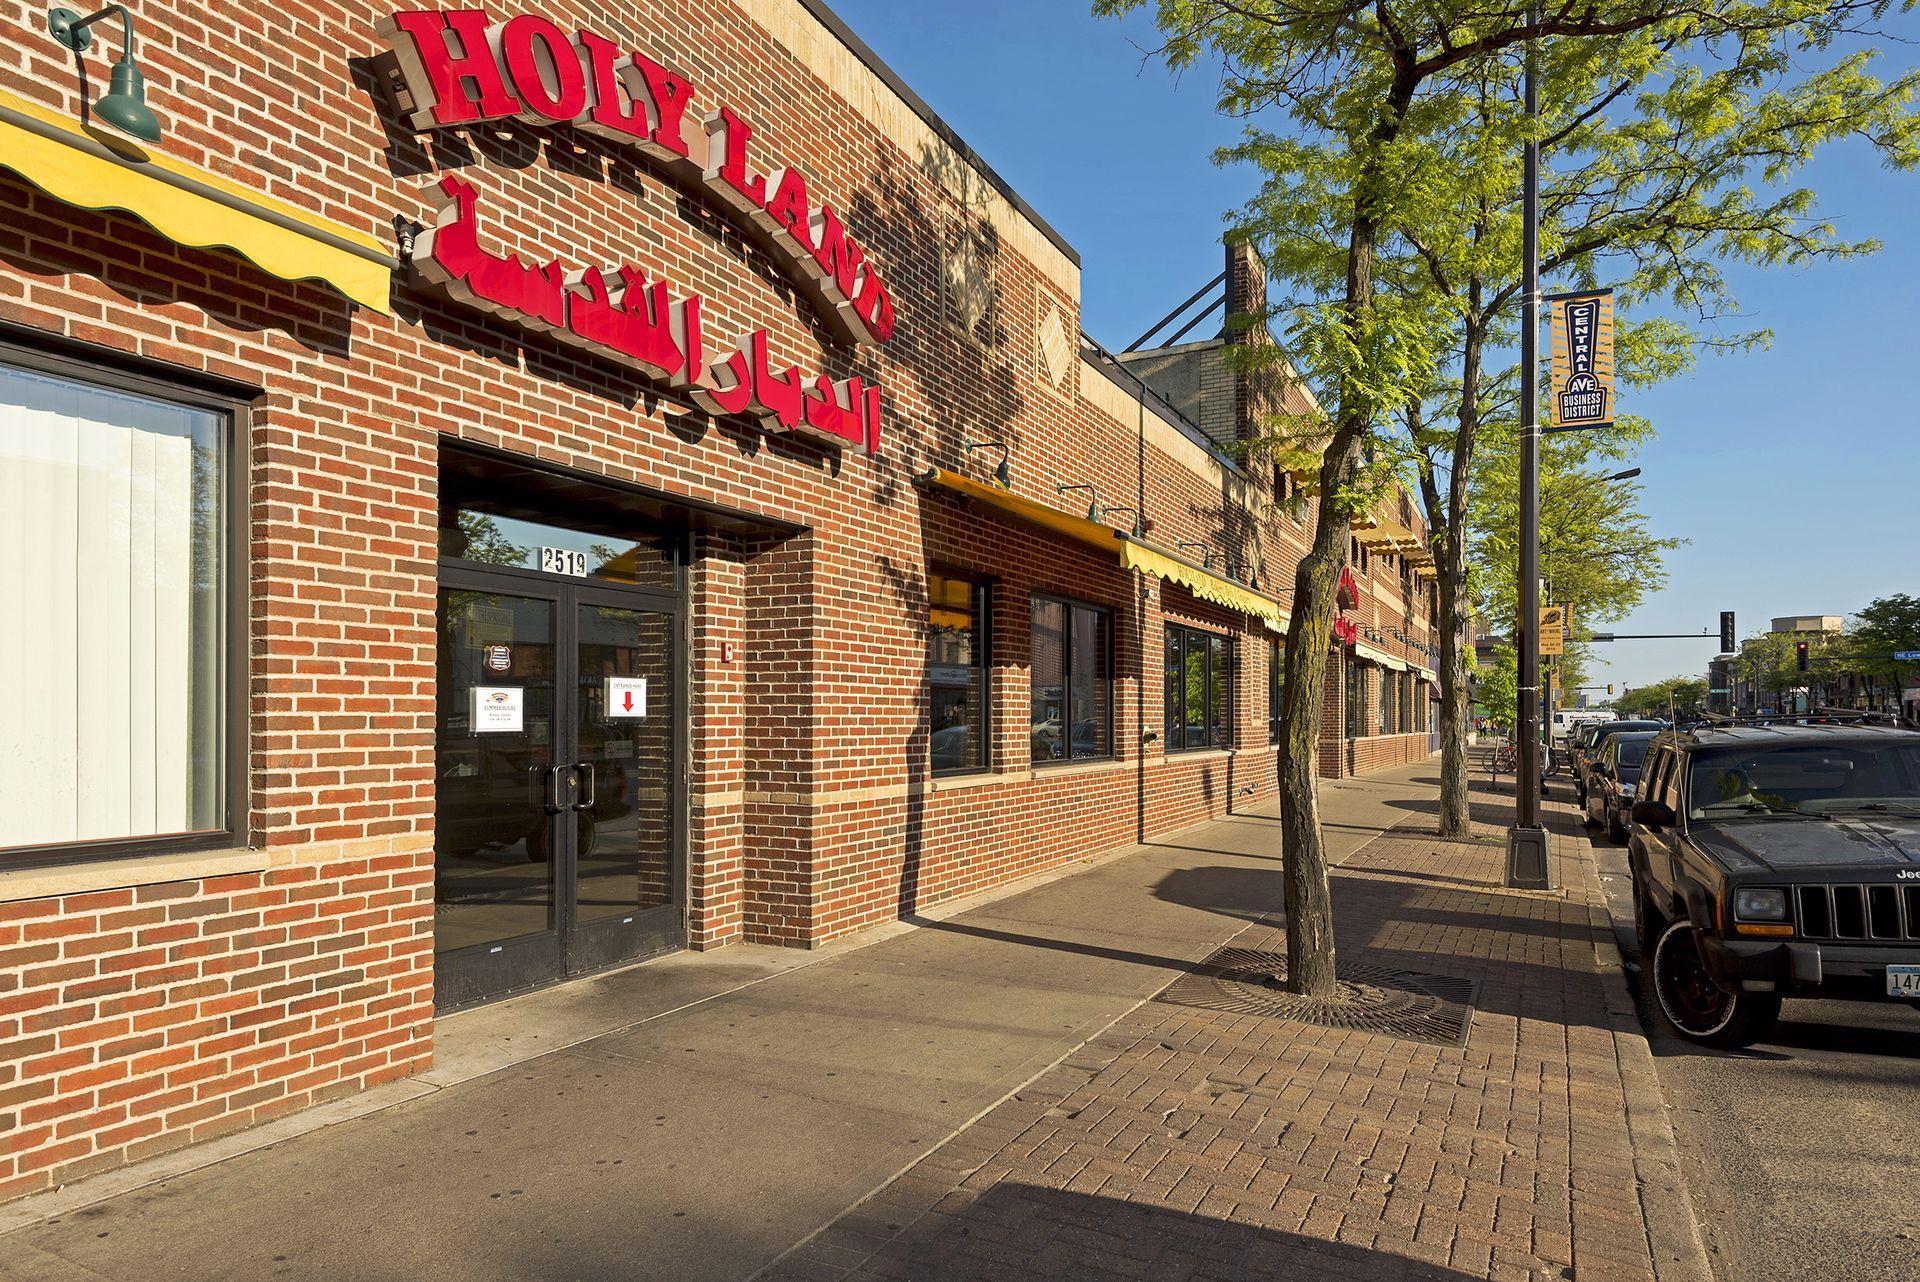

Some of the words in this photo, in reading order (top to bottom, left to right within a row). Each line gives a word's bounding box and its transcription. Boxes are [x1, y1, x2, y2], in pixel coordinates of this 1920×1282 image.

[393, 9, 695, 158] HOLY
[718, 106, 895, 346] LAND
[1573, 307, 1590, 372] CENTRAL
[706, 328, 881, 455] الديار
[1571, 378, 1595, 392] AVE
[1564, 393, 1601, 406] BUSINESS
[1564, 404, 1600, 418] DISTRICT
[544, 547, 585, 575] 2519
